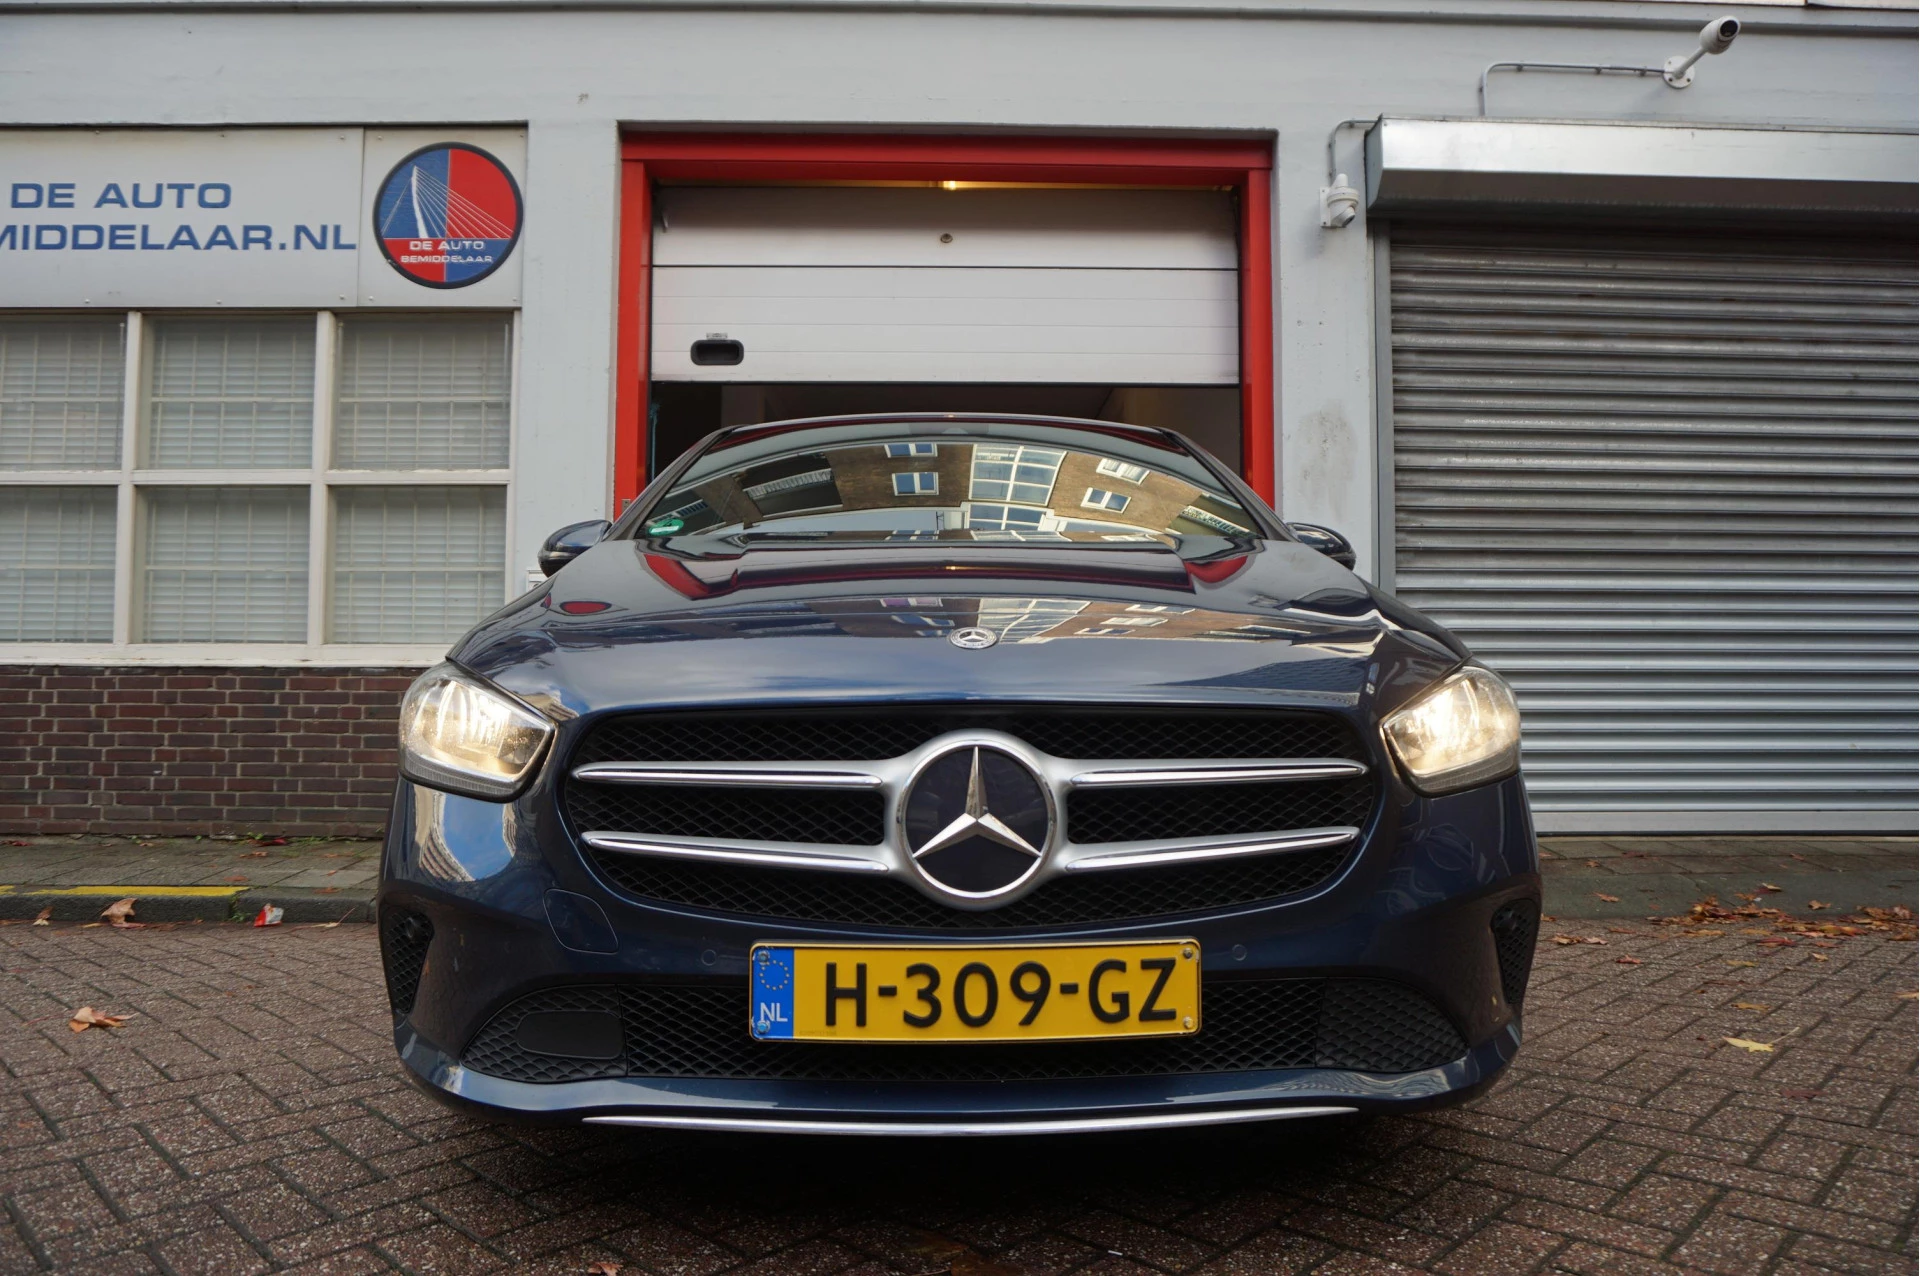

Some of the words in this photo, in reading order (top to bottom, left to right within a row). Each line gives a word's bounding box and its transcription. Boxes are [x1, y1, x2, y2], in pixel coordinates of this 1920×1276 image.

[11, 183, 76, 208] DE
[93, 183, 232, 208] AUTO
[409, 240, 433, 251] DE
[438, 240, 485, 250] AUTO
[401, 255, 493, 263] BEMIDDELAAR
[825, 958, 1177, 1027] H-309-GZ
[760, 1002, 788, 1022] NL
